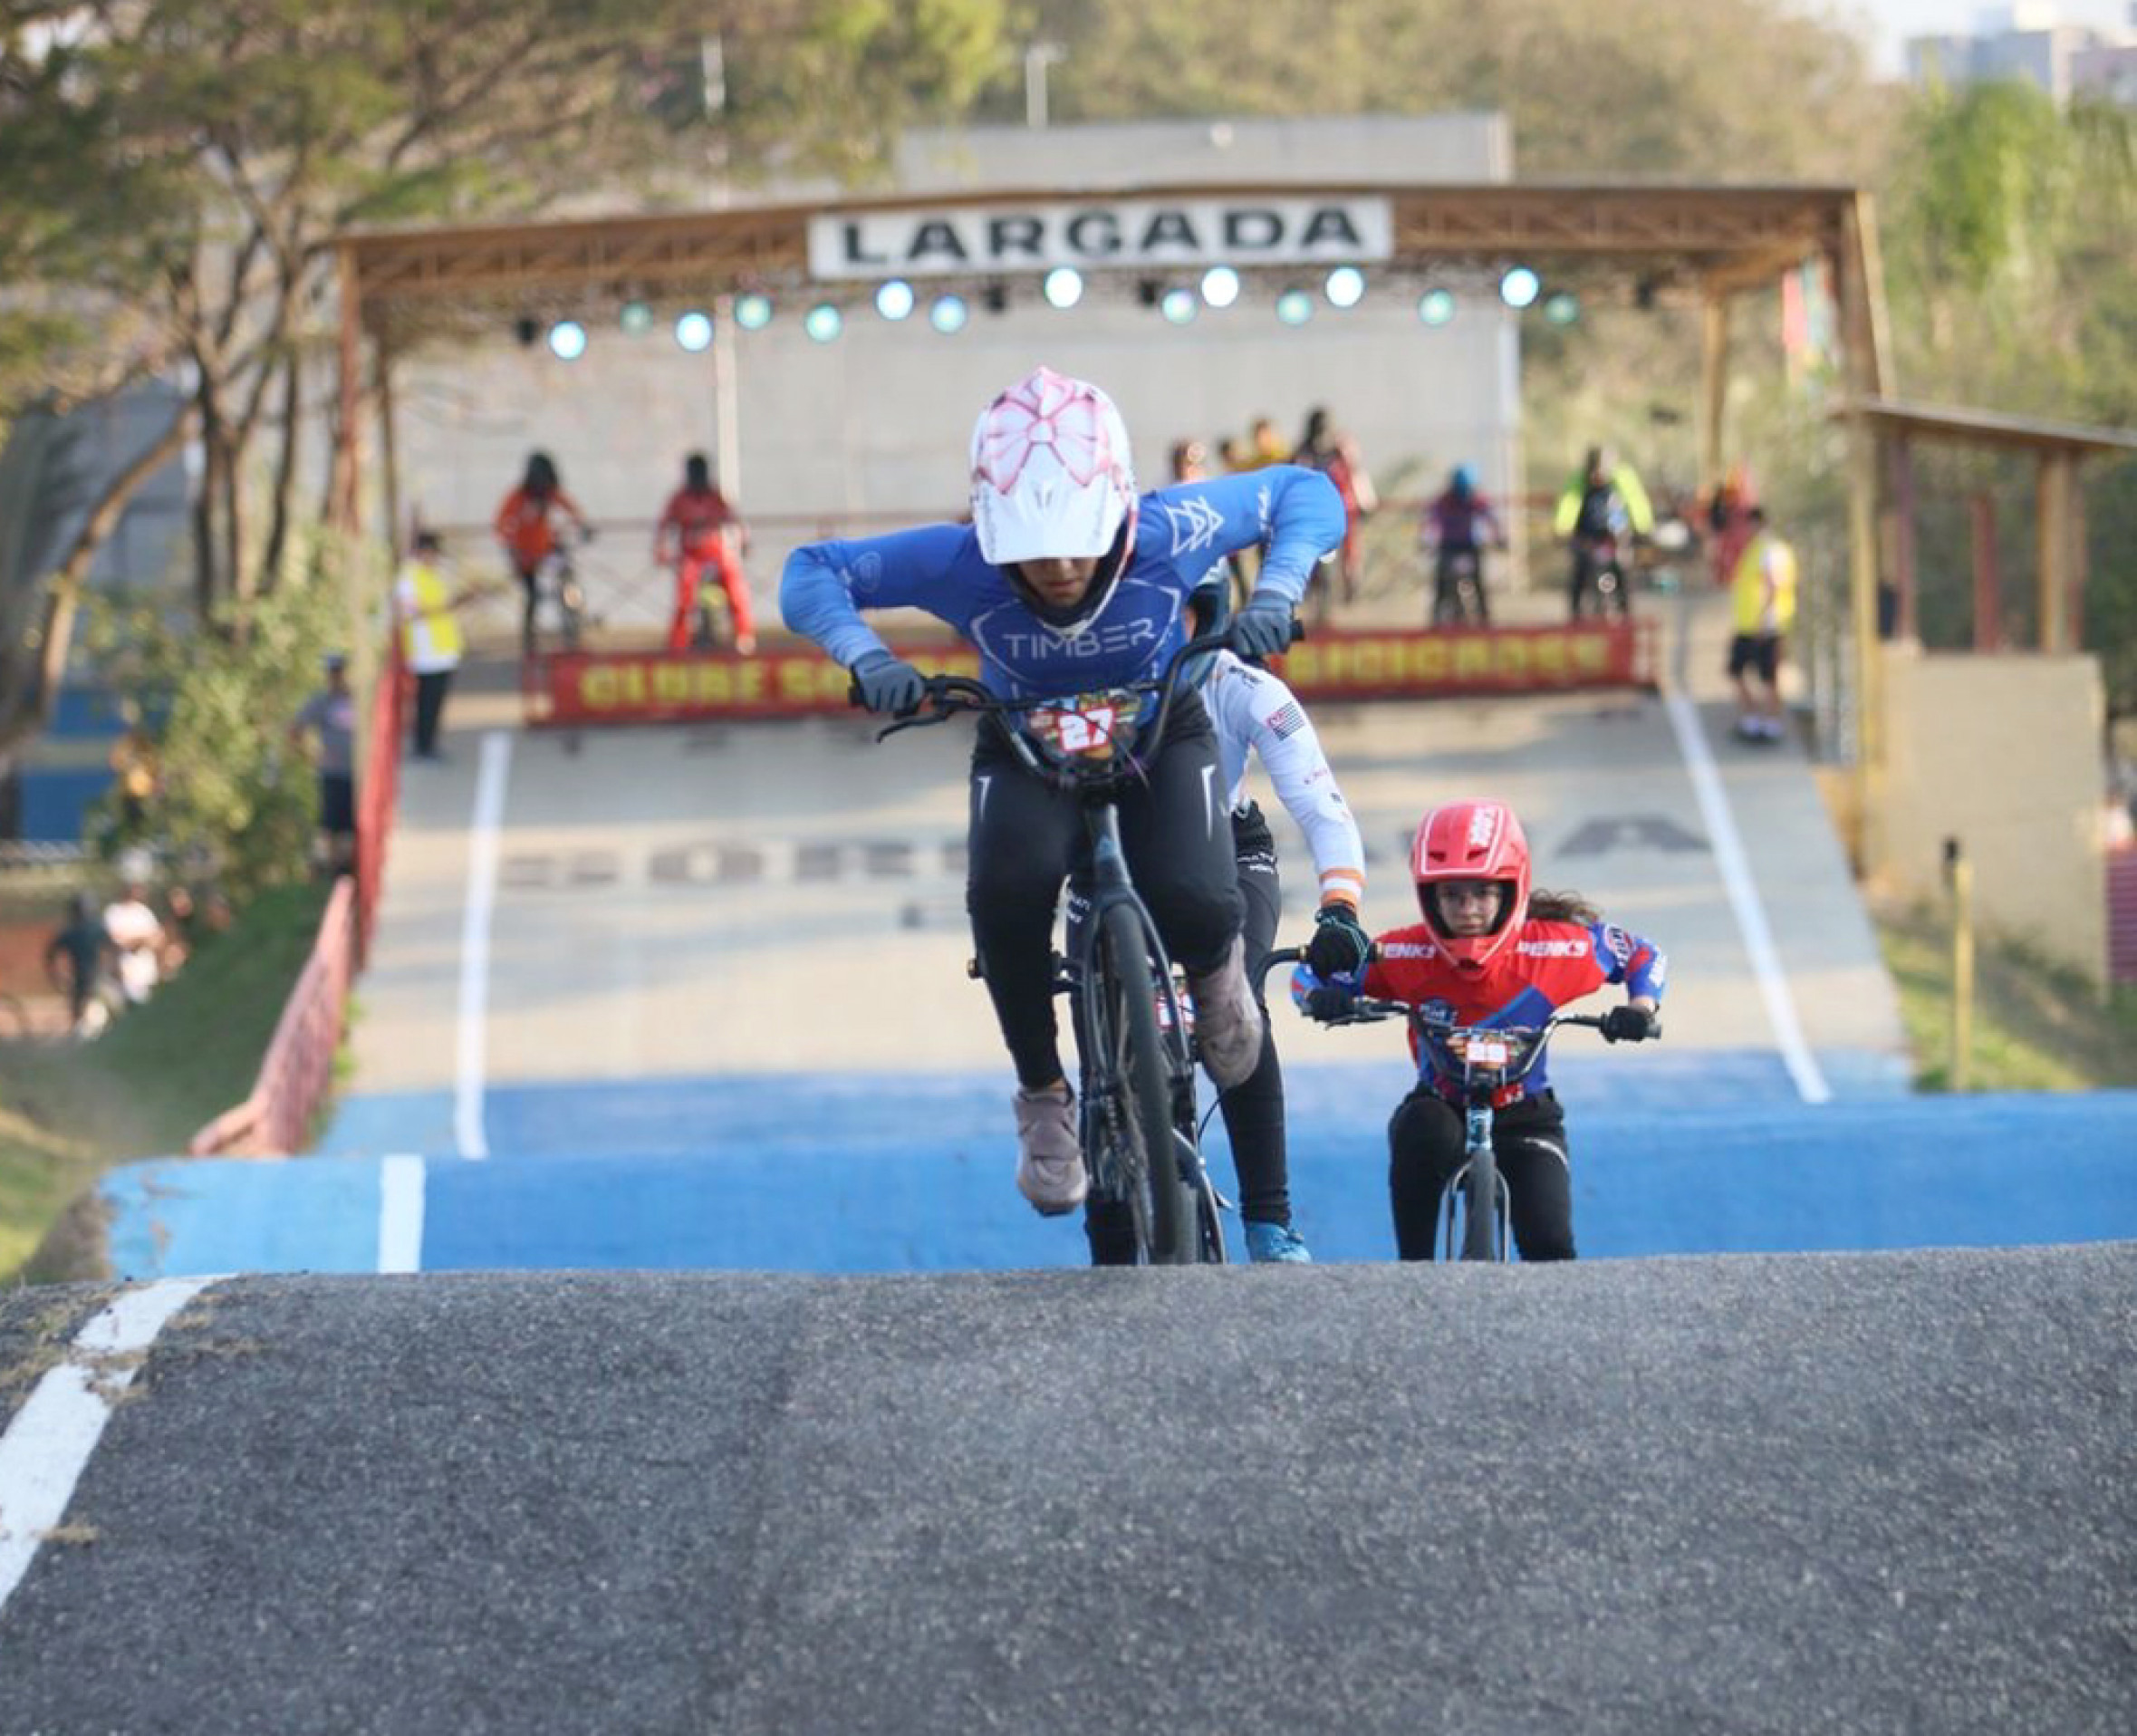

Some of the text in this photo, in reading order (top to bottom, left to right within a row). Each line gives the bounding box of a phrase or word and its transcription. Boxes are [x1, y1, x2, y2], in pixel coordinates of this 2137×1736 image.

[843, 207, 1361, 264] LARGADA
[1001, 617, 1156, 660] TIMBER
[1058, 708, 1112, 750] 27
